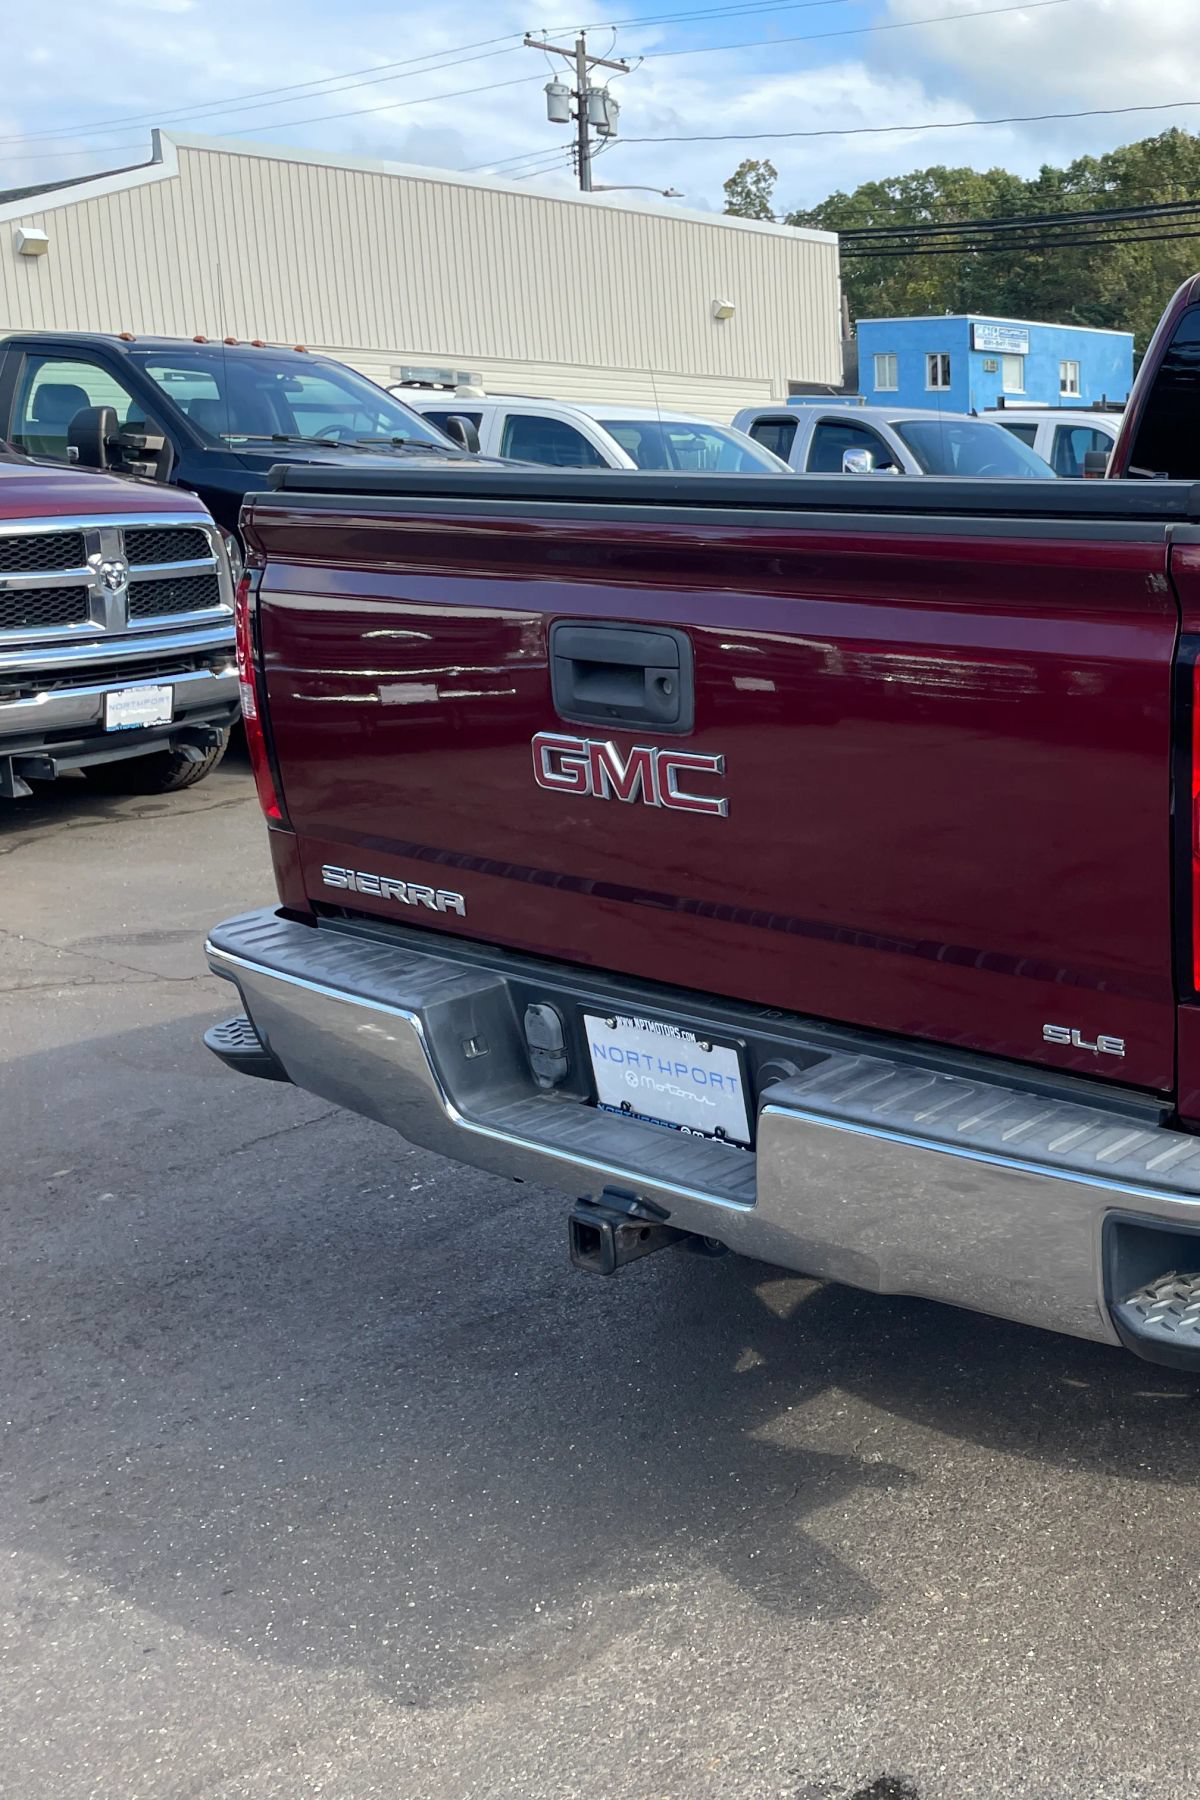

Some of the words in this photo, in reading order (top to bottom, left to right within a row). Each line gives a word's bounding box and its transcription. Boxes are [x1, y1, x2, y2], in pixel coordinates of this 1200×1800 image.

[109, 696, 170, 711] NORTHPORT
[531, 731, 729, 818] GMC
[321, 864, 467, 917] SIERRA
[615, 1015, 698, 1043] WWW.NPTMOTORS.COM
[1042, 1024, 1126, 1057] SLE
[592, 1043, 738, 1094] NORTHPORT
[640, 1073, 716, 1107] Motors
